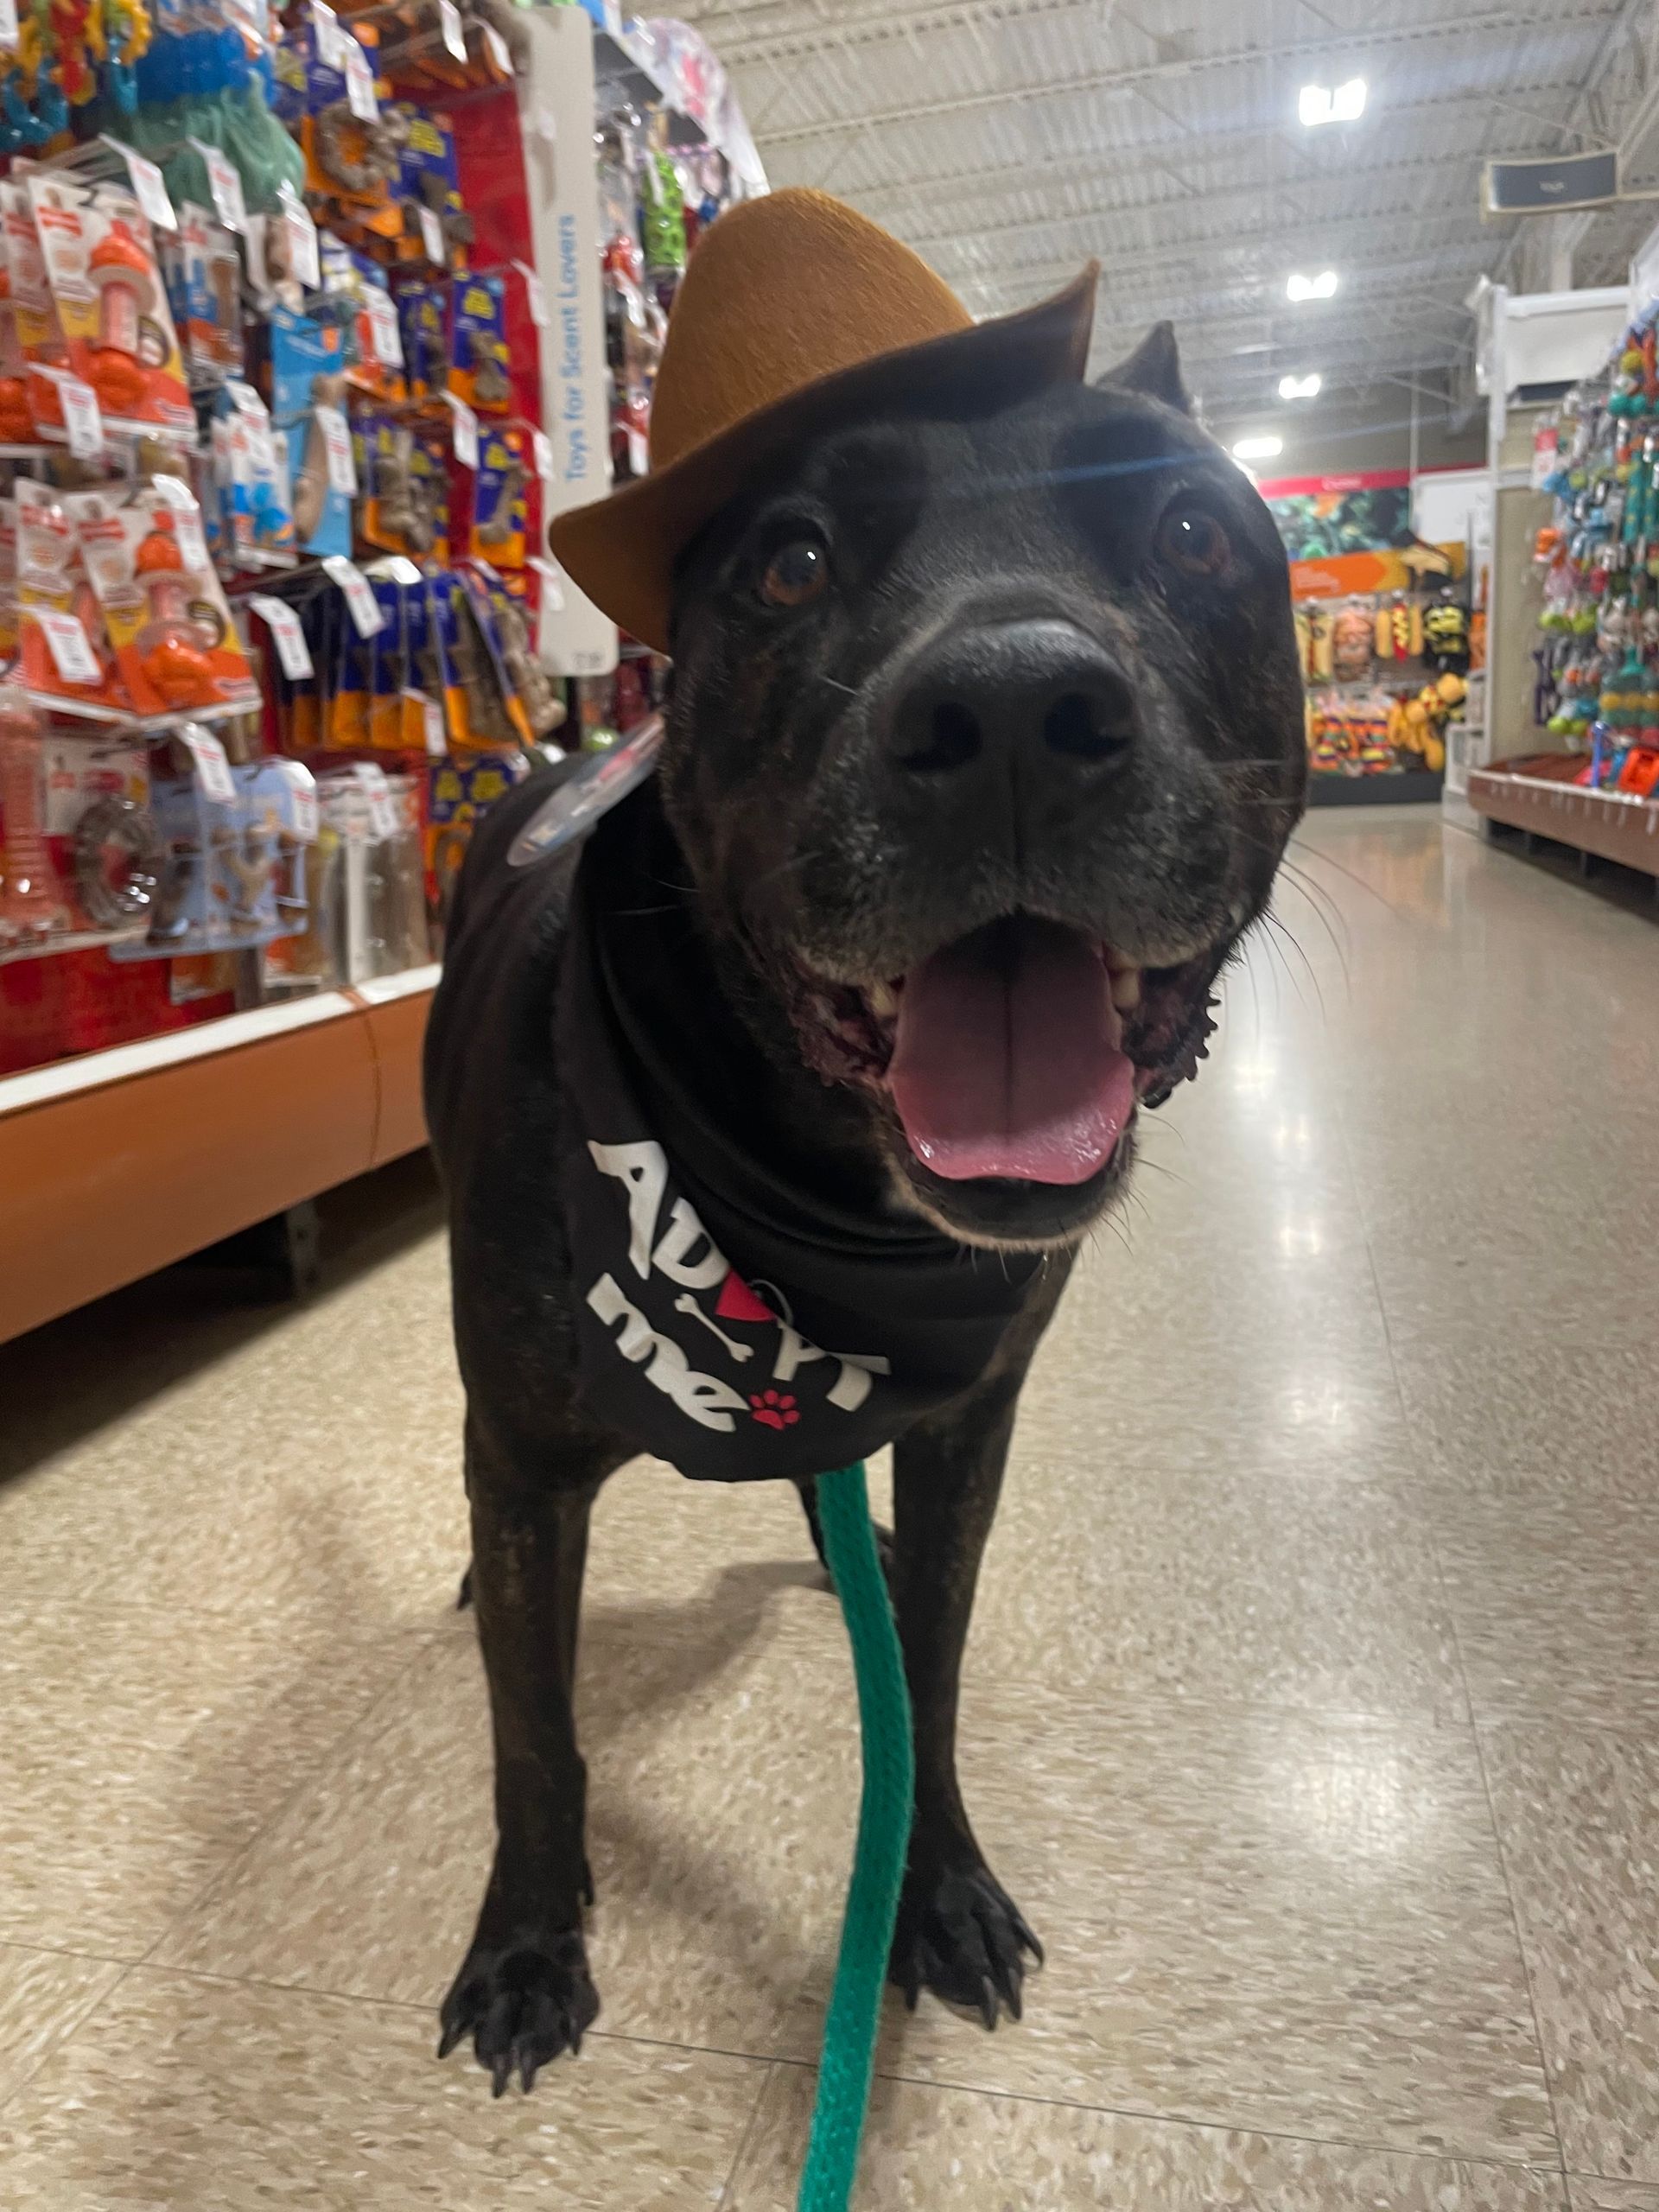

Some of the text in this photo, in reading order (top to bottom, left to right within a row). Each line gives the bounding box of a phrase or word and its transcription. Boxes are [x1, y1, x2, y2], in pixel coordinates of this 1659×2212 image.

[557, 213, 587, 481] Toys for Scent Lovers
